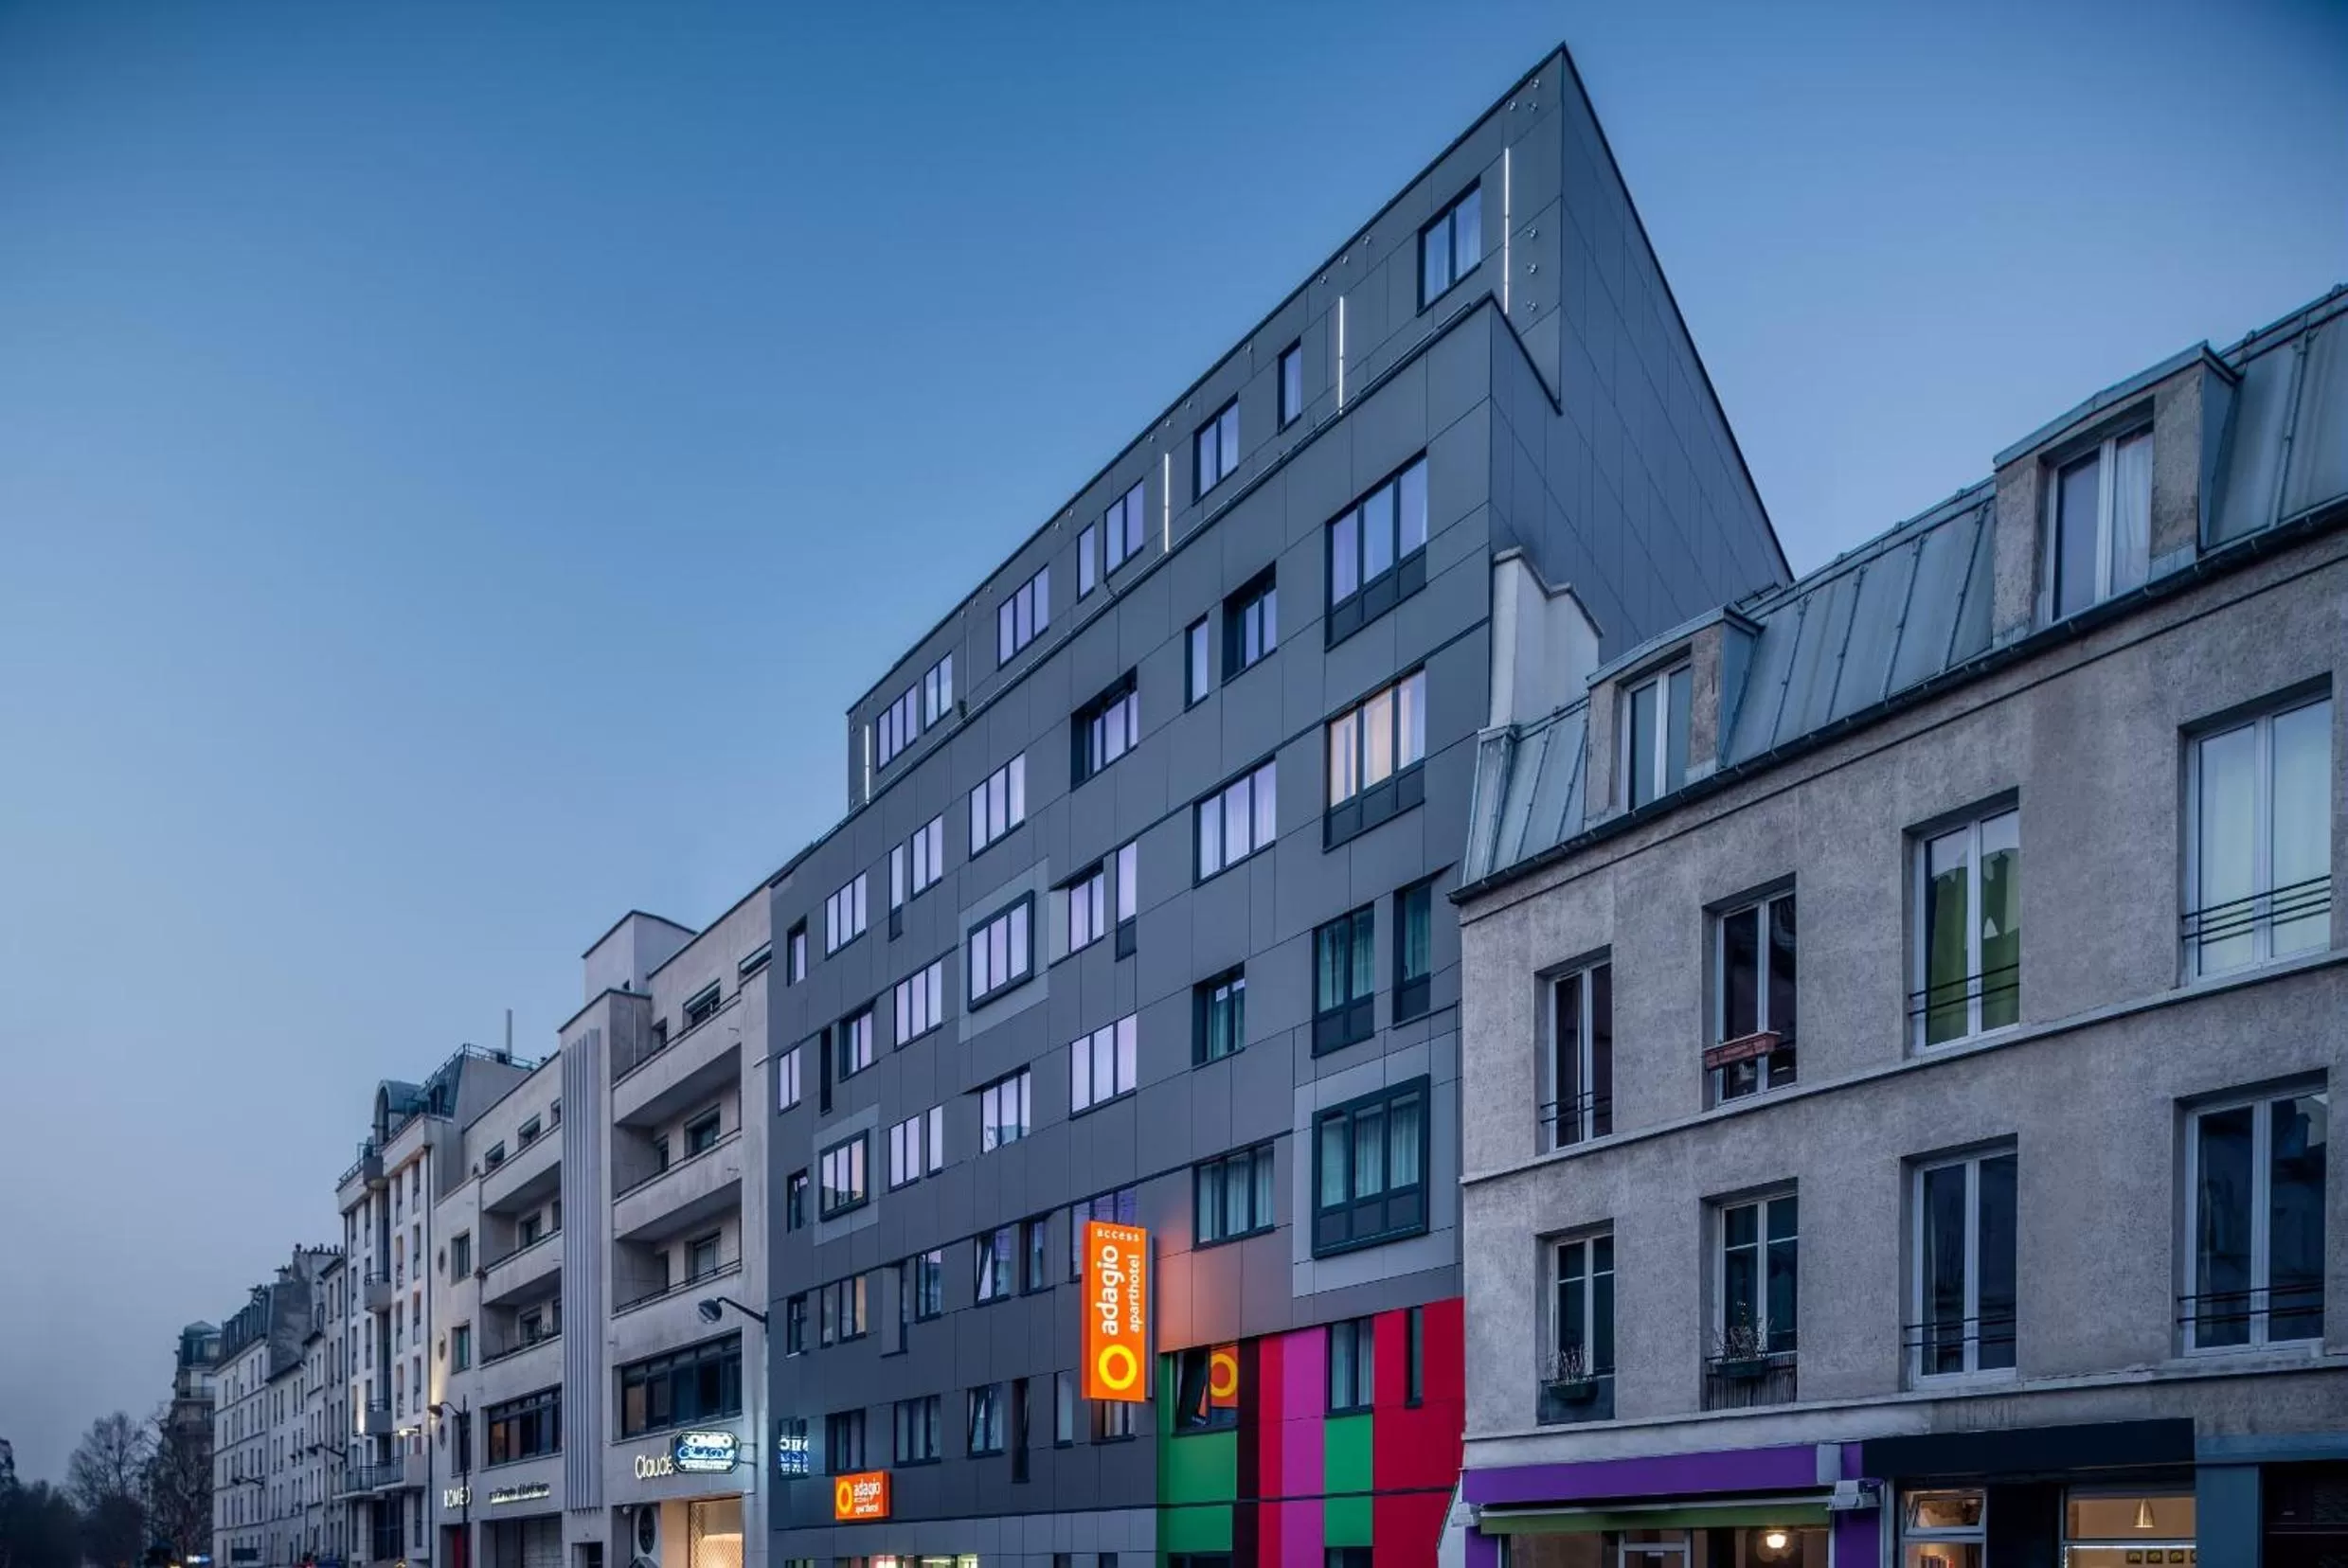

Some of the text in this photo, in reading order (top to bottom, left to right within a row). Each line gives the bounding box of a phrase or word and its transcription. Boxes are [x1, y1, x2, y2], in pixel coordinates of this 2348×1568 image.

[1097, 1228, 1140, 1242] access
[1096, 1245, 1125, 1336] adagio
[1127, 1255, 1143, 1333] aparthotel
[636, 1452, 673, 1479] Claude
